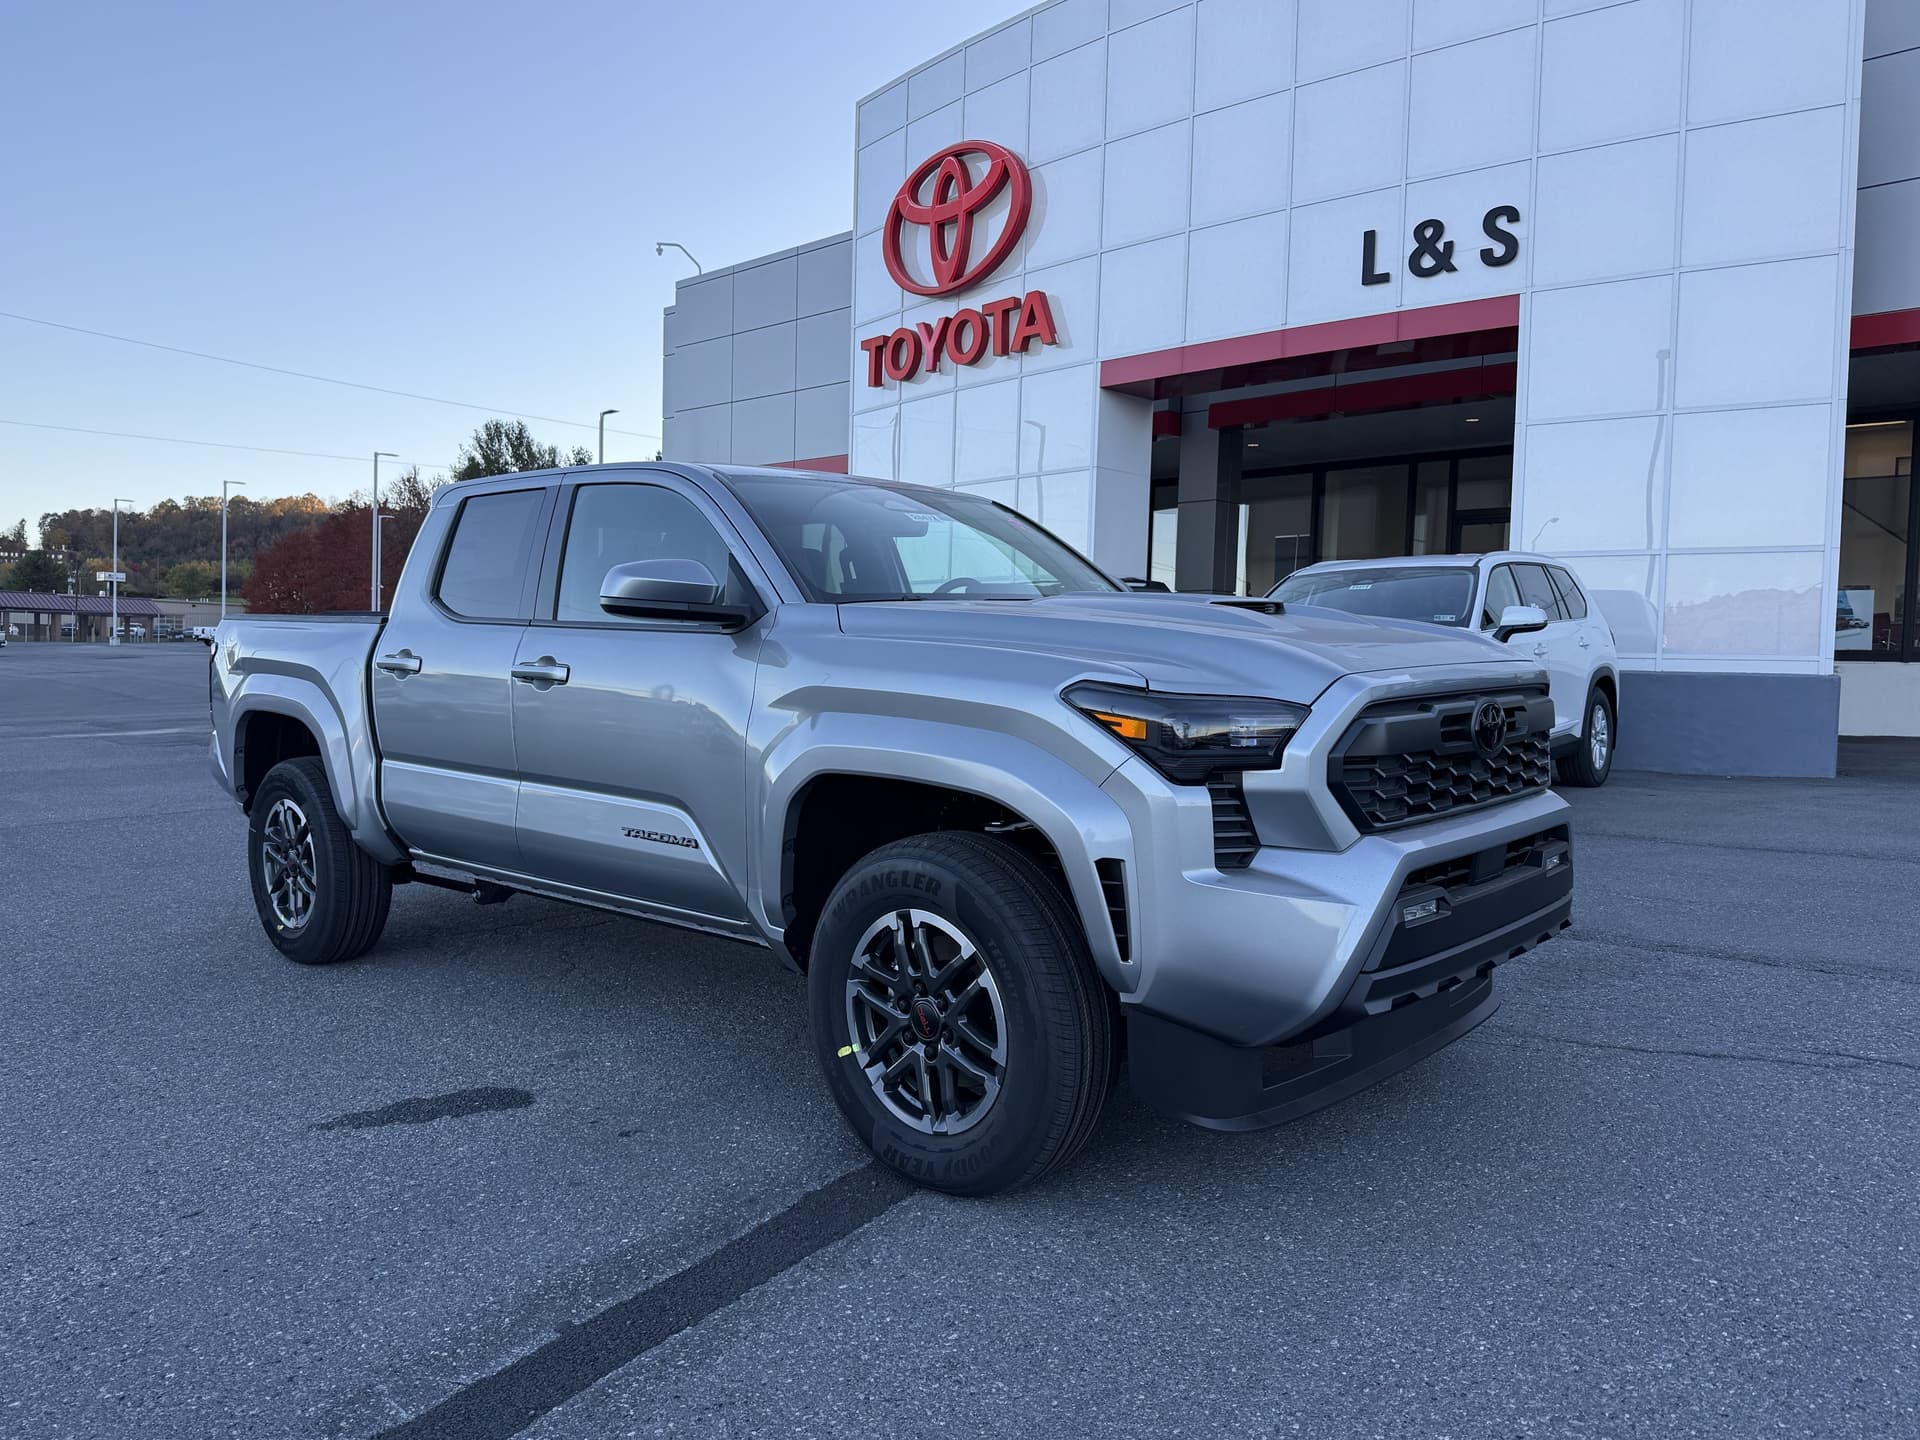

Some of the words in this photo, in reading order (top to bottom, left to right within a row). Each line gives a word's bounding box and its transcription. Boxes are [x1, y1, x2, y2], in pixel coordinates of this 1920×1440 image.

[1361, 229, 1391, 286] L
[1408, 218, 1458, 278] &
[1480, 205, 1521, 268] S
[861, 290, 1058, 387] TOYOTA
[621, 826, 699, 849] TACOMA
[831, 870, 942, 918] WRANGLER
